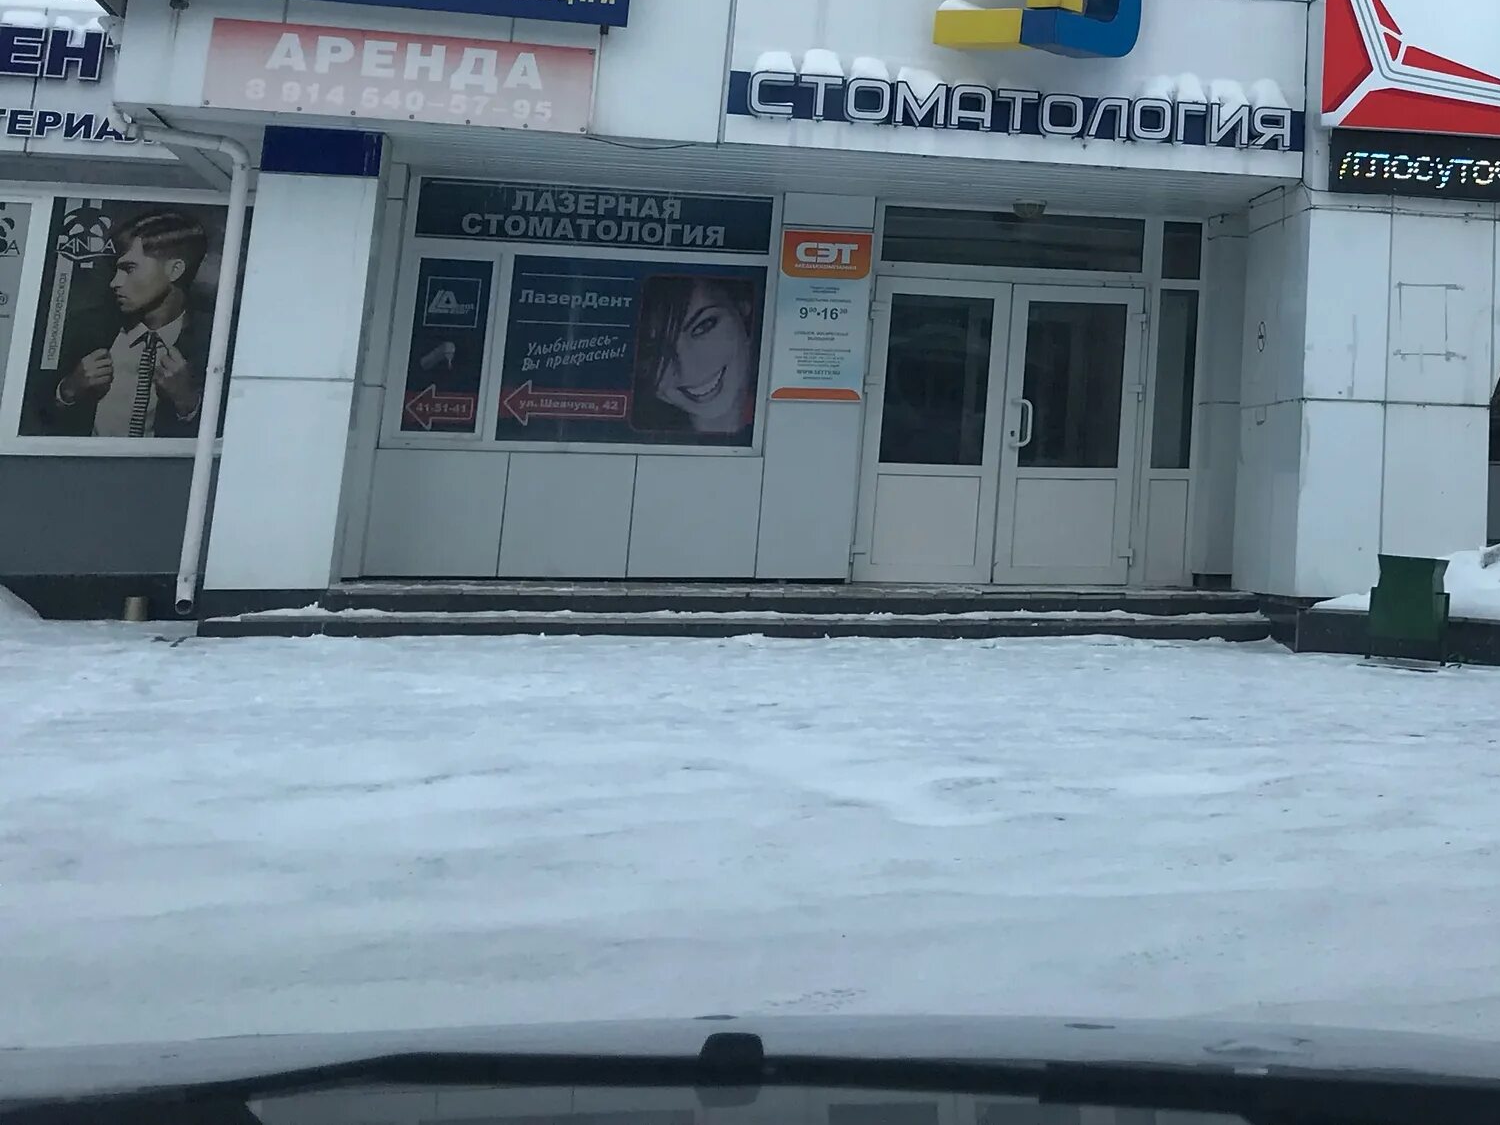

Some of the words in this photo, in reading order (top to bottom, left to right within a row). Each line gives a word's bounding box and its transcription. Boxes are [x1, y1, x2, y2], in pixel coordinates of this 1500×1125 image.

[0, 26, 120, 81] ЕН
[265, 32, 543, 94] АРЕНДА
[282, 81, 346, 105] 914
[748, 70, 1294, 151] СТОМАТОЛОГИЯ
[511, 189, 682, 220] ЛАЗЕРНАЯ
[56, 234, 117, 254] PANDA
[461, 212, 726, 247] СТОМАТОЛОГИЯ
[796, 241, 859, 265] СЭТ
[518, 288, 633, 309] ЛазерДент
[520, 356, 541, 372] Вы
[545, 342, 627, 370] прекрасны!
[519, 399, 538, 410] ул.
[602, 400, 619, 411] 42
